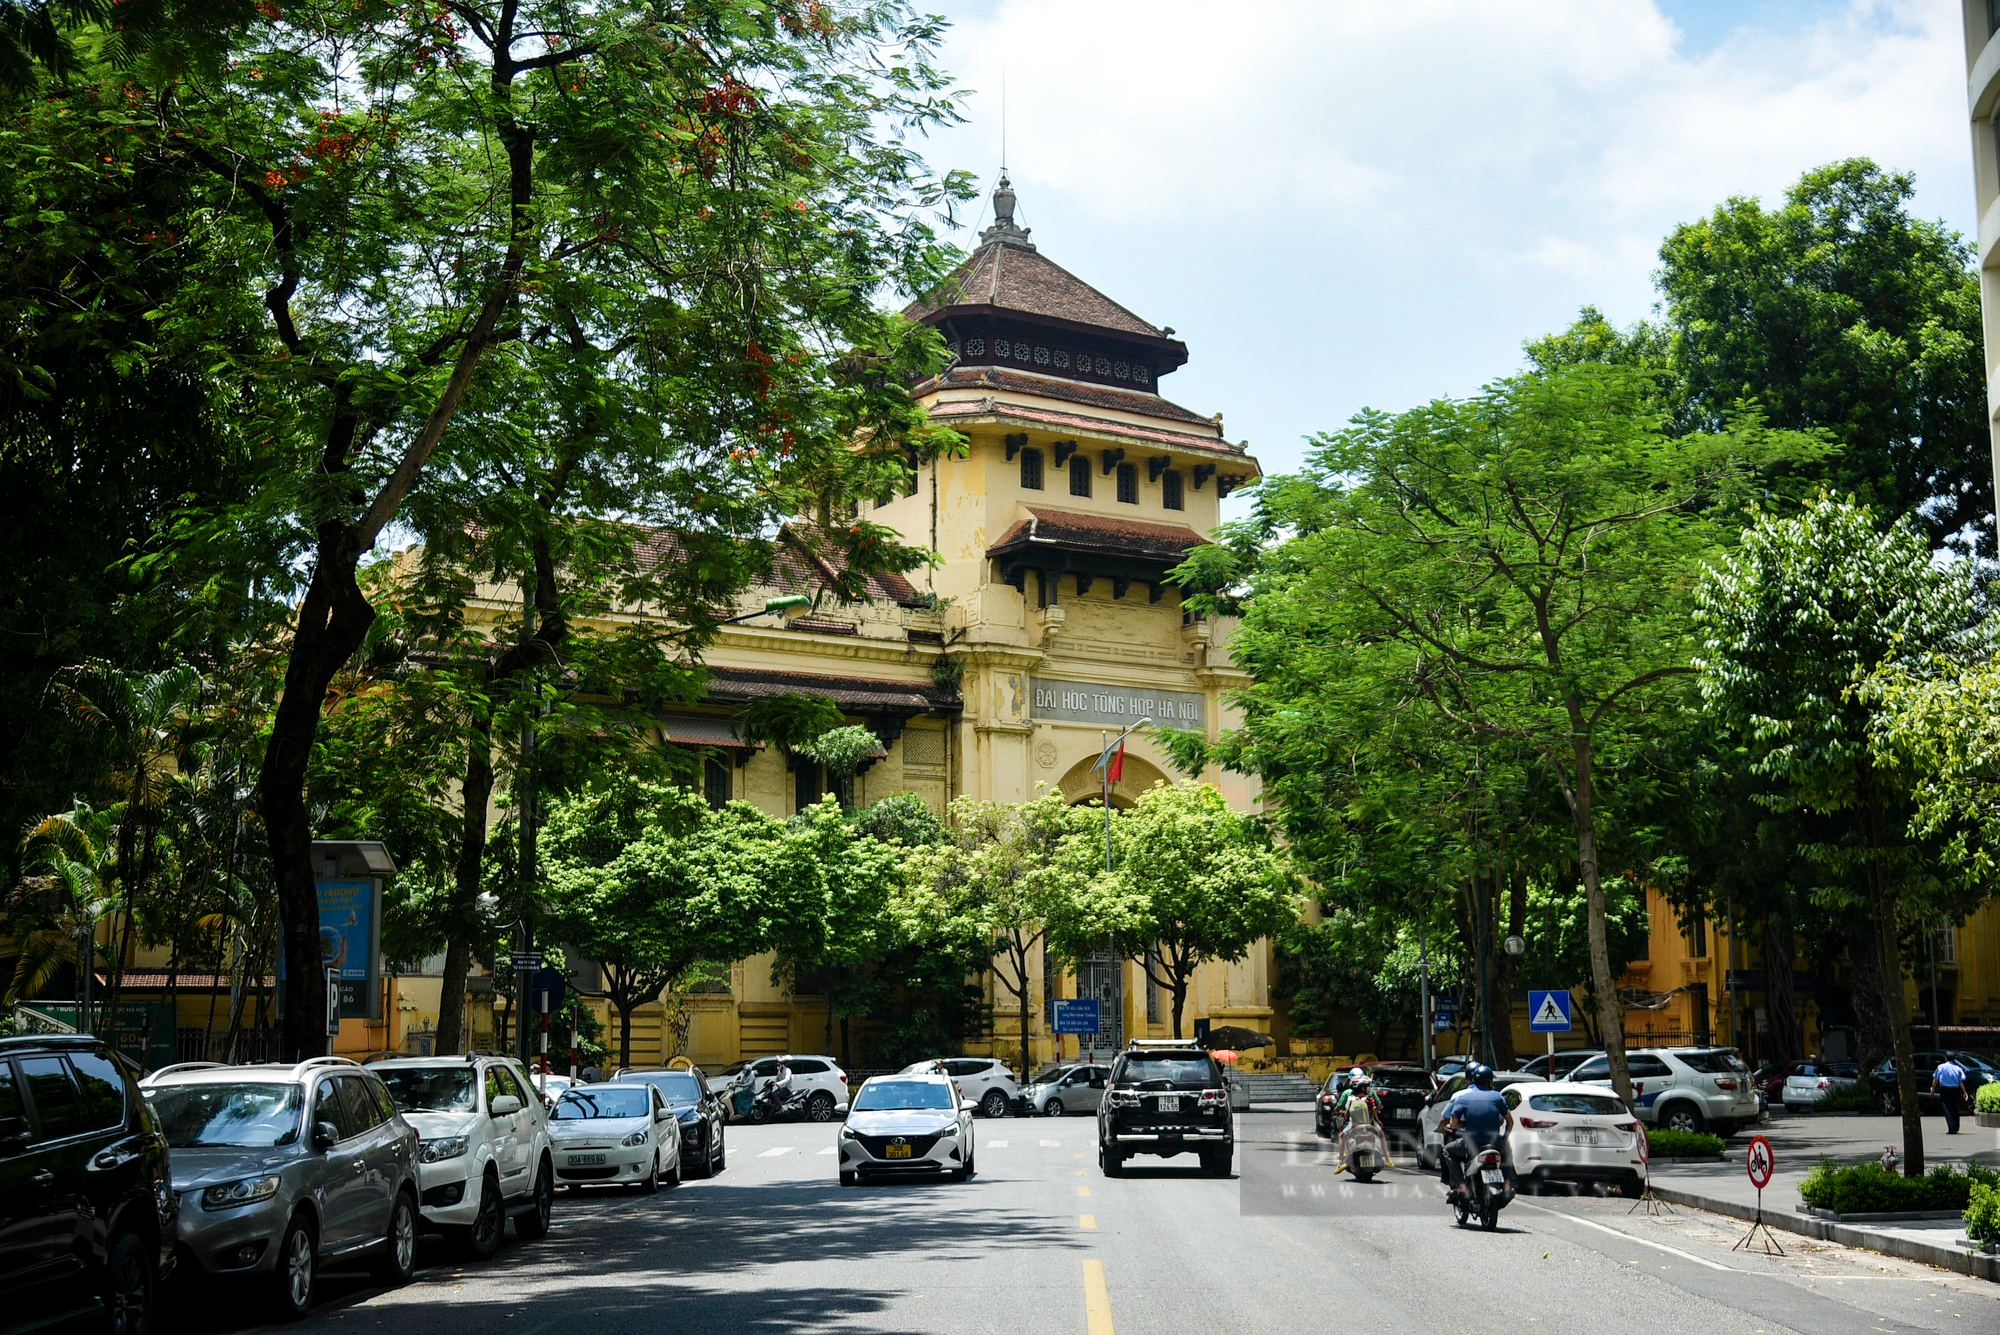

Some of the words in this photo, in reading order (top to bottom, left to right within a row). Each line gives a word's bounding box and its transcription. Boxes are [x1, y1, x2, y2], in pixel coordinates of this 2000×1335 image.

[1036, 689, 1056, 710] ĐẠI
[1062, 691, 1087, 712] HỌC
[1092, 691, 1124, 714] TỔNG
[1158, 698, 1175, 719] HÀ
[1179, 700, 1198, 722] NỘI
[331, 983, 338, 1021] P
[343, 995, 354, 1003] 86
[120, 1033, 137, 1043] 60
